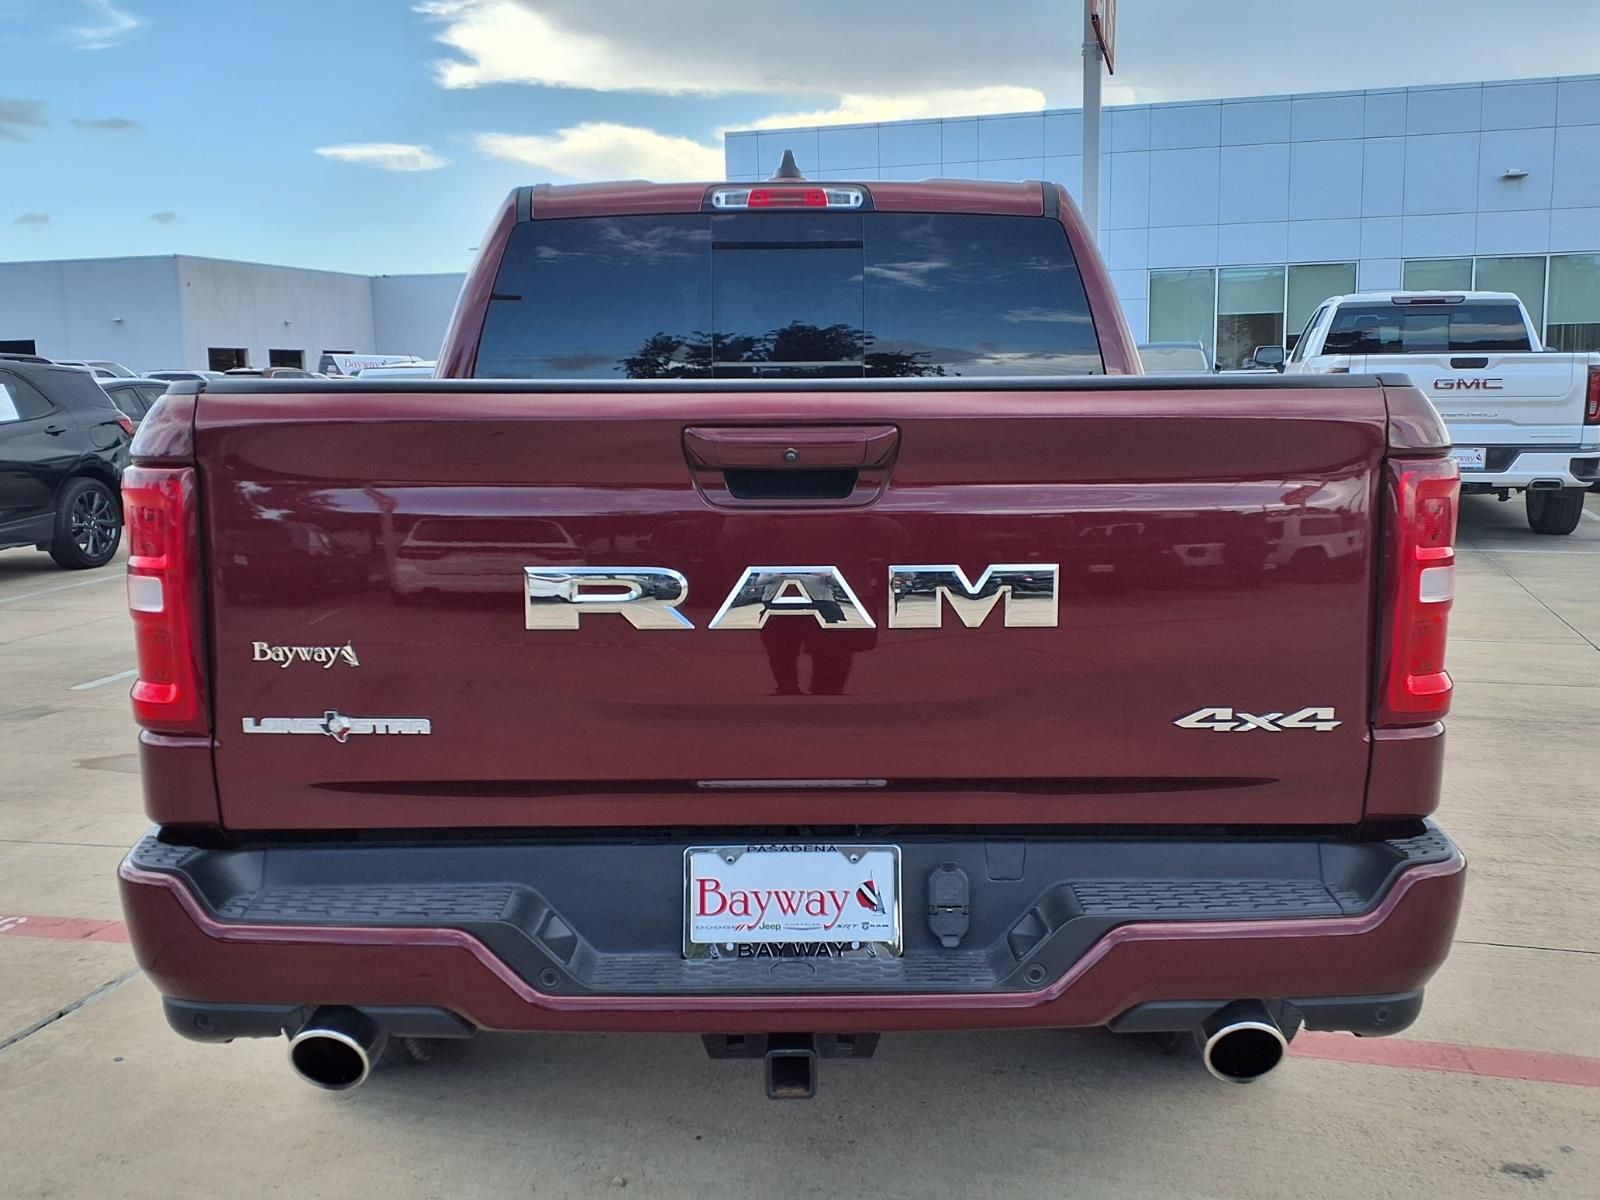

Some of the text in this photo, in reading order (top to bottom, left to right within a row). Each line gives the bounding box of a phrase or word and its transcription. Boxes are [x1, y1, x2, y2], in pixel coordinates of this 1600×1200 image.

[1434, 378, 1503, 390] GMC
[523, 563, 1060, 630] RAM
[251, 641, 341, 669] Bayway
[349, 718, 432, 735] STAR
[1173, 707, 1343, 732] 4x4
[746, 845, 838, 853] PASADENA
[695, 878, 850, 931] Bayway
[758, 921, 782, 931] Jeep
